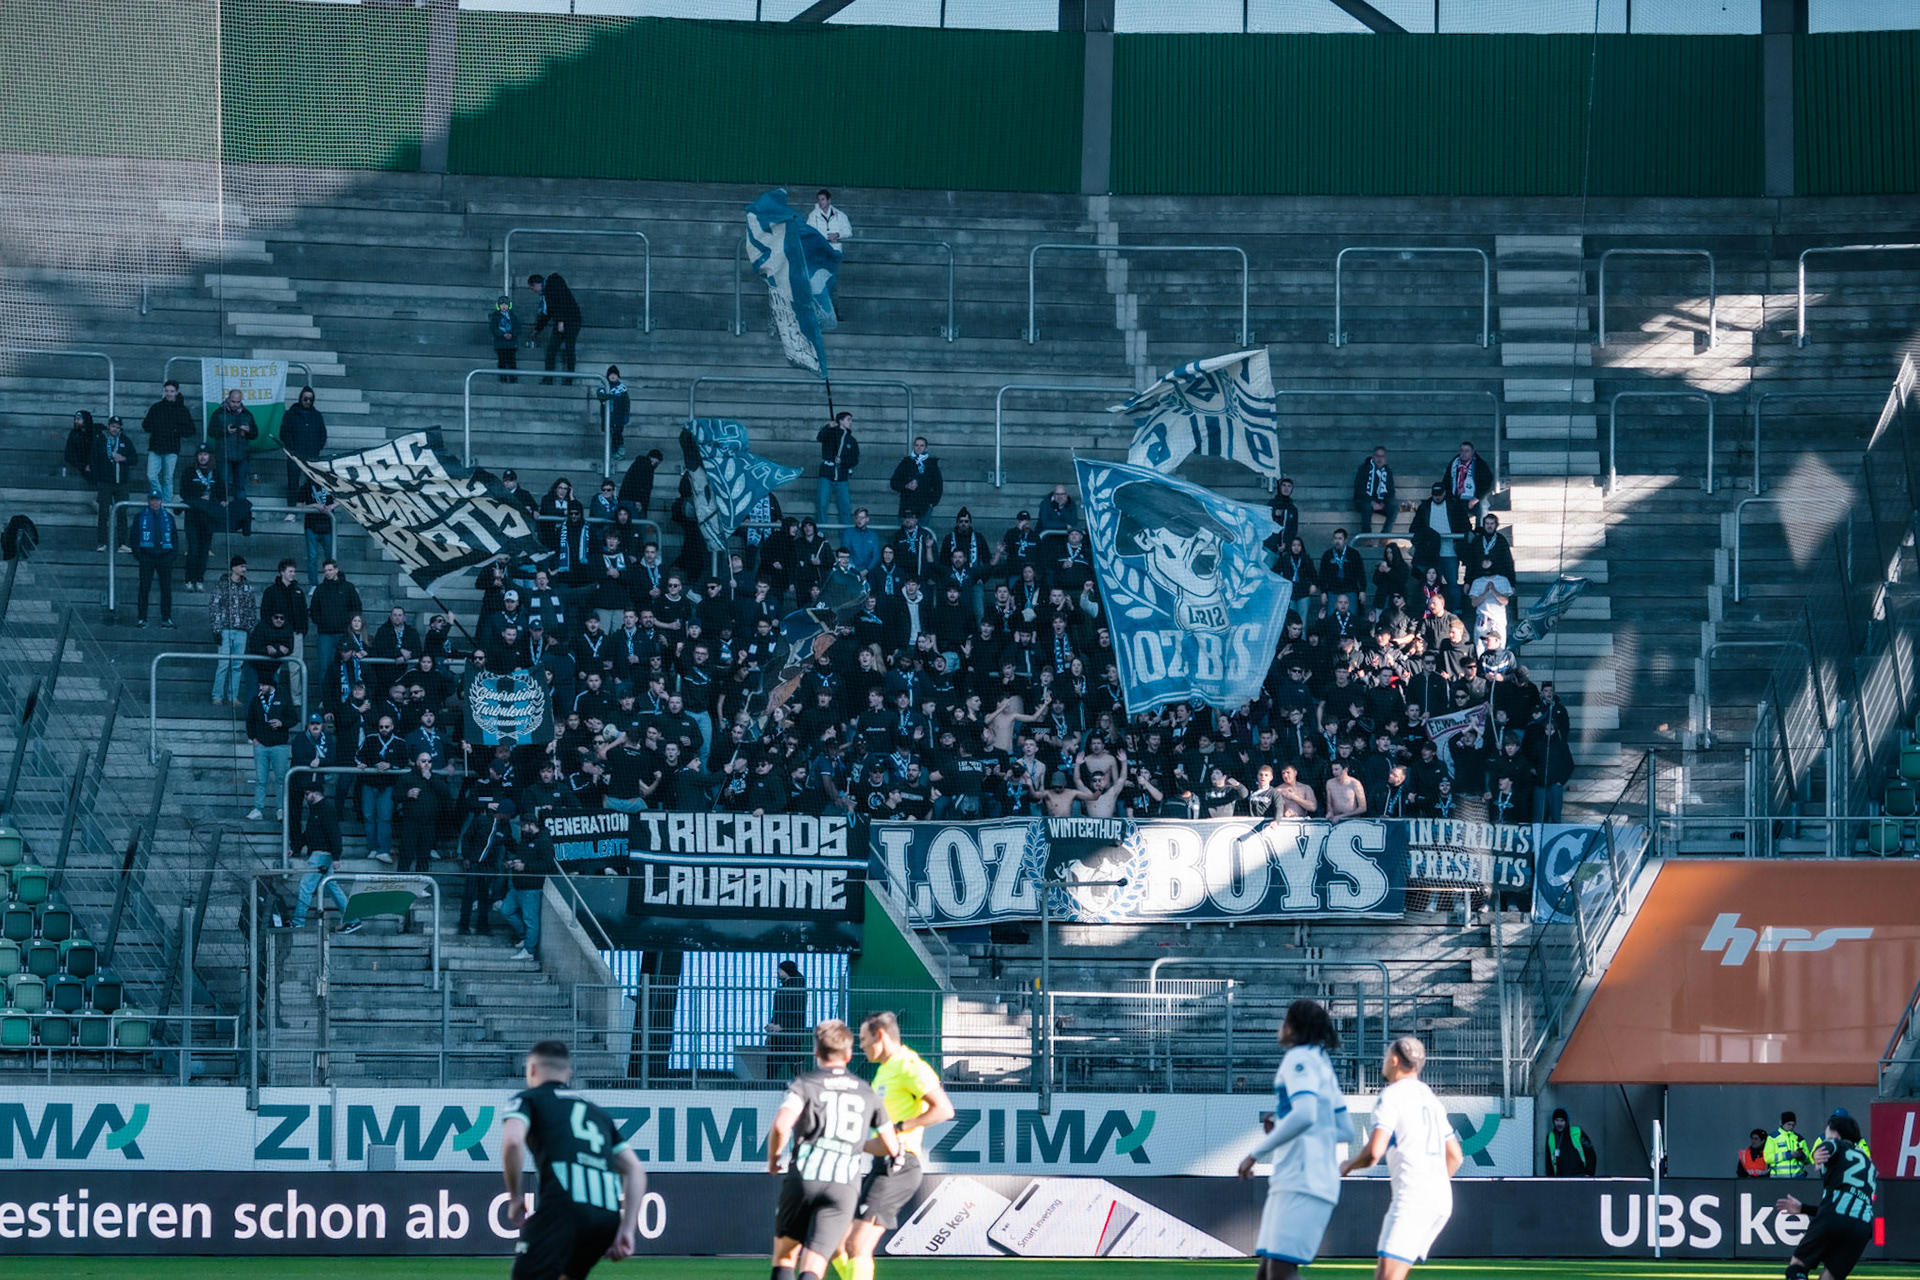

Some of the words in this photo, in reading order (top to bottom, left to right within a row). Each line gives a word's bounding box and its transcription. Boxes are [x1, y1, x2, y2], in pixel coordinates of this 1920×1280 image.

[214, 362, 278, 377] LIBERTÉ
[240, 378, 254, 388] ET
[222, 388, 273, 401] PTRIE
[475, 702, 537, 718] Turbulente
[544, 812, 629, 836] GENERATION
[639, 811, 848, 858] TRICARDS
[1047, 818, 1123, 840] WINTERTHUR
[1408, 817, 1532, 854] INTERDITS
[553, 838, 630, 861] URBULENTE
[879, 826, 1041, 920] LOZ
[1137, 819, 1391, 914] BOYS
[1409, 850, 1528, 887] PRESENTS
[643, 864, 848, 911] LAUSANNE
[255, 1103, 495, 1161] ZIMA
[570, 1101, 605, 1154] 4
[598, 1105, 778, 1163] ZIM
[819, 1090, 866, 1144] 16
[929, 1108, 1156, 1164] ZIMA
[0, 1188, 212, 1240] estieren
[234, 1188, 386, 1240] schon
[405, 1188, 470, 1240] ab
[1016, 1225, 1039, 1249] Smart
[1035, 1197, 1064, 1232] investing
[1599, 1193, 1723, 1250] UBS
[925, 1227, 953, 1253] UBS
